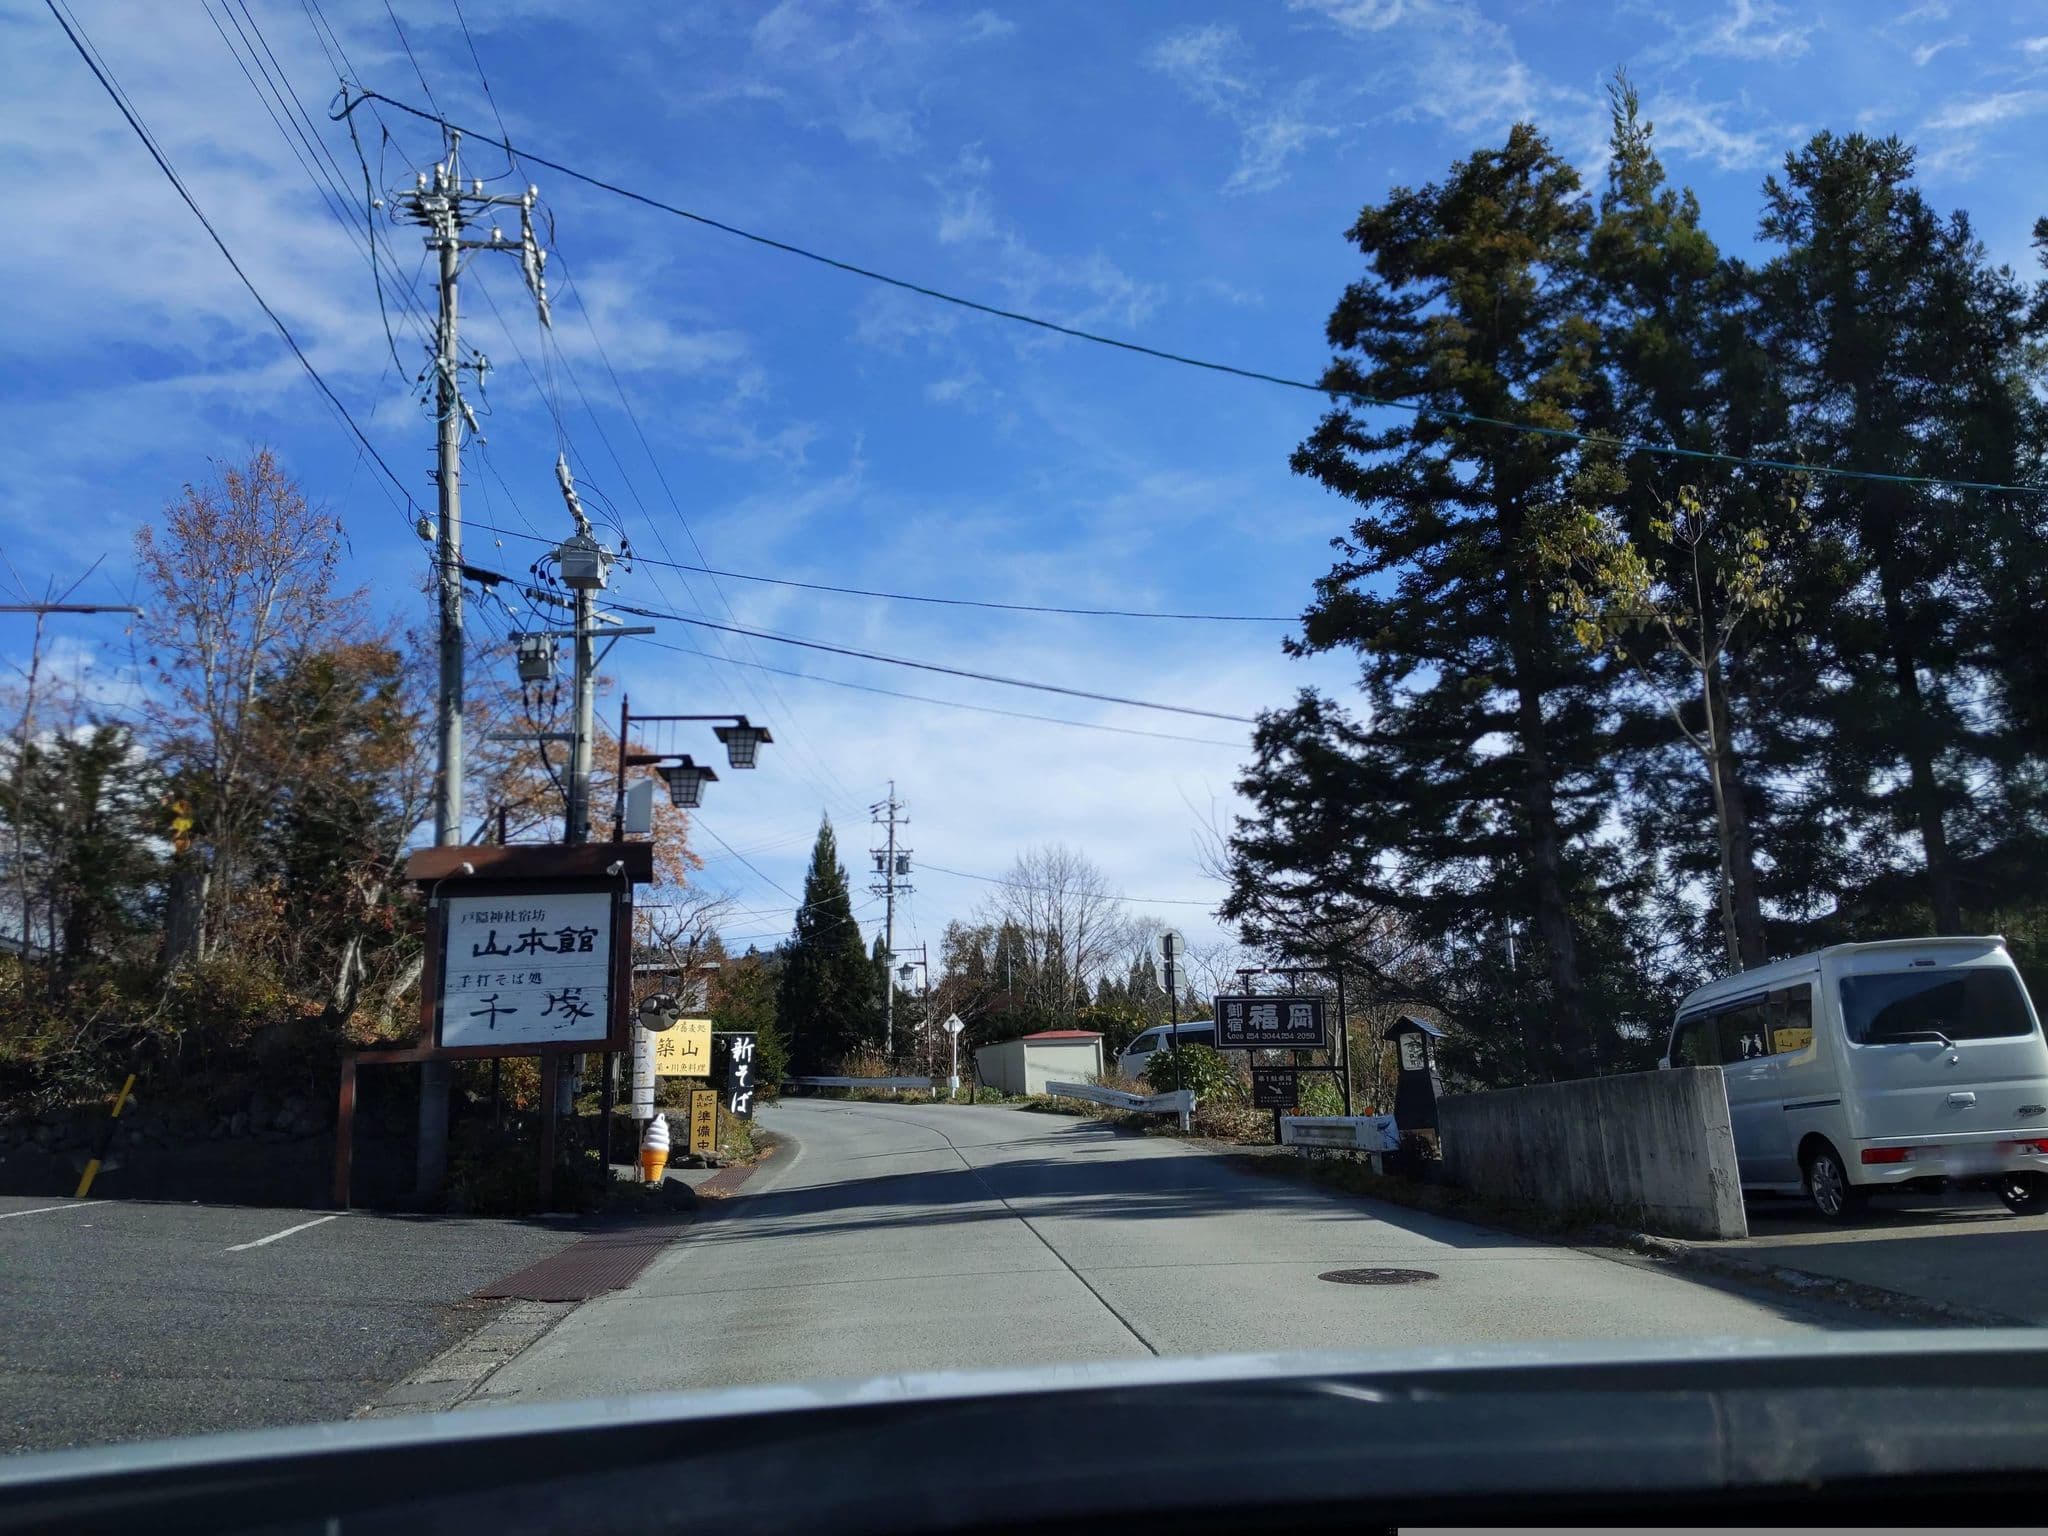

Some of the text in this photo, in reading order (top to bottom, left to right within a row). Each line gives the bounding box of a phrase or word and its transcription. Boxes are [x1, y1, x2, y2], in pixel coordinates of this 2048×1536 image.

[460, 908, 546, 925] 戸隠神社宿坊
[472, 926, 599, 958] 山本館
[1248, 1004, 1313, 1031] 福岡
[656, 1037, 698, 1057] 築山
[731, 1037, 755, 1114] 新そば
